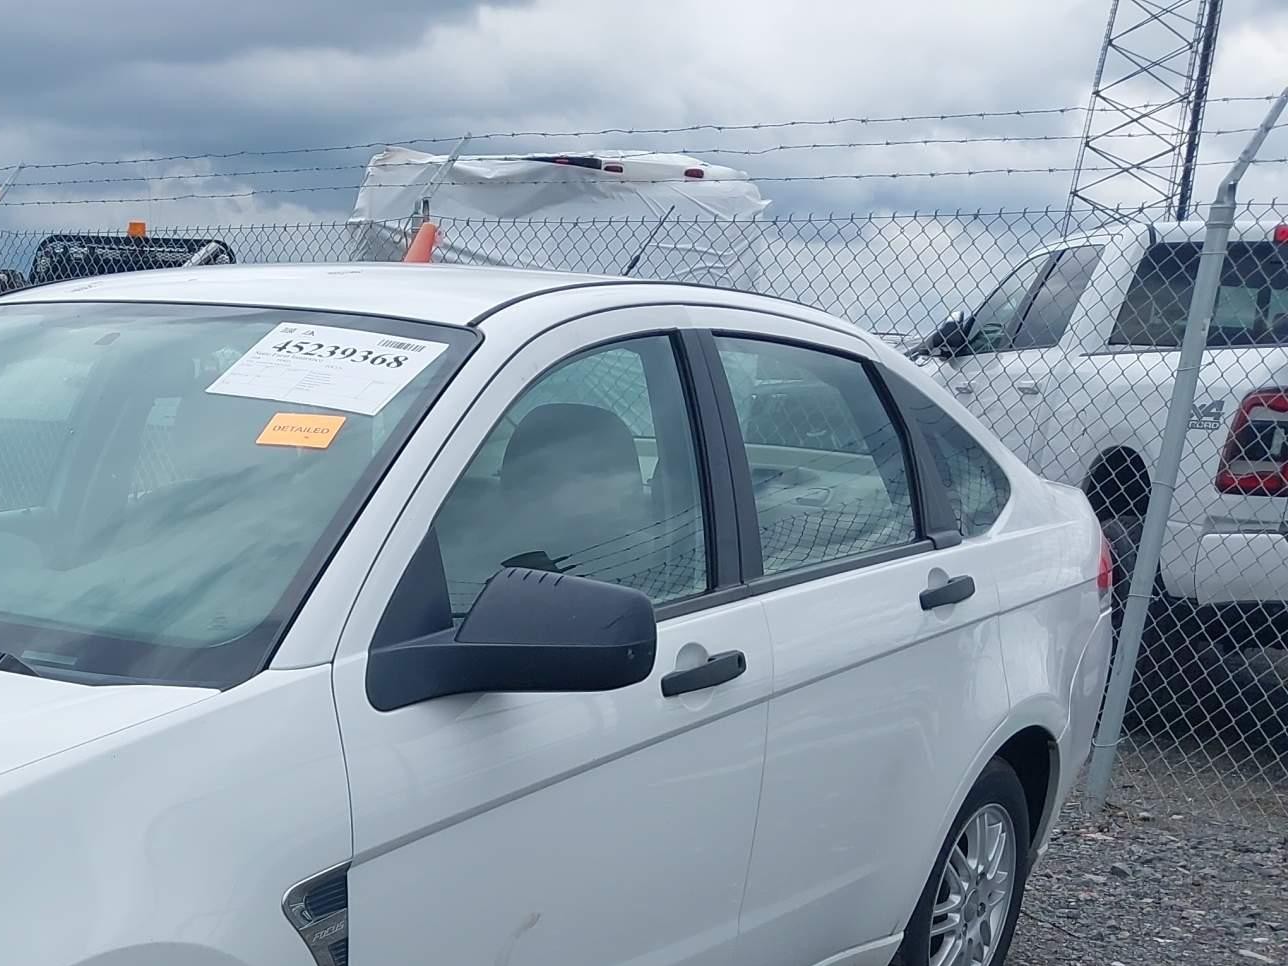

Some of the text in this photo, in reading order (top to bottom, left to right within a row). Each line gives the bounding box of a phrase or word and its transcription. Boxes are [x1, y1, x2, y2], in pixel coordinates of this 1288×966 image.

[272, 340, 409, 369] 45239368
[272, 425, 330, 434] DETAILED
[312, 920, 345, 942] FOCUS
